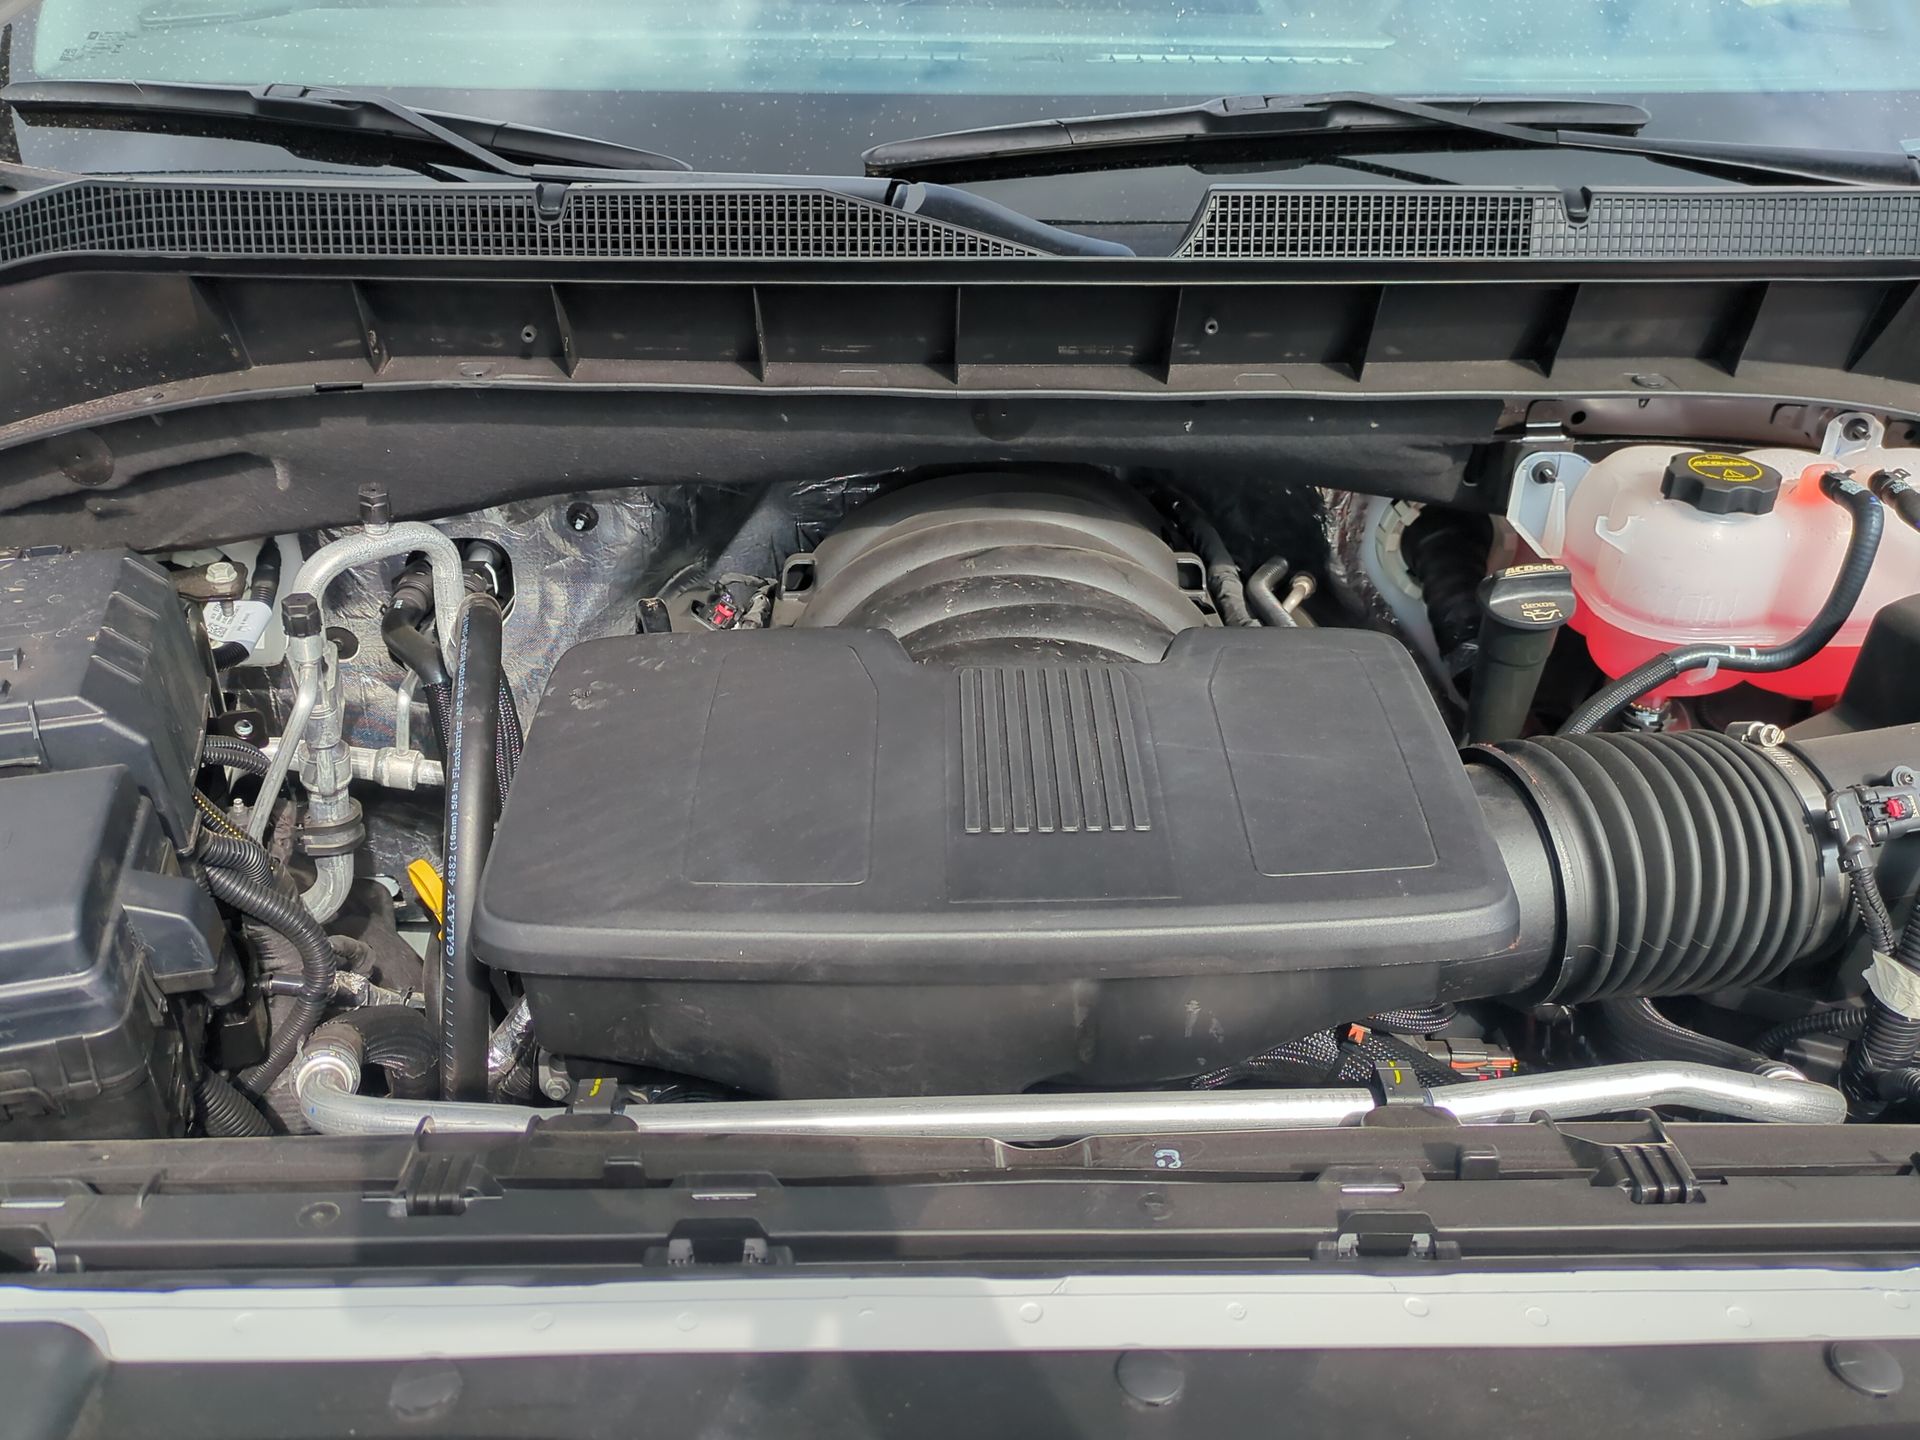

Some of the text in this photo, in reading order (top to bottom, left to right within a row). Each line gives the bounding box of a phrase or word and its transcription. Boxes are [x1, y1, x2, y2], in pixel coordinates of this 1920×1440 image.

[1504, 563, 1565, 577] ACDelco
[451, 720, 463, 779] Flexbarrier
[449, 810, 459, 851] (16mm)
[447, 854, 457, 886] 4882
[445, 890, 457, 957] GALAXY
